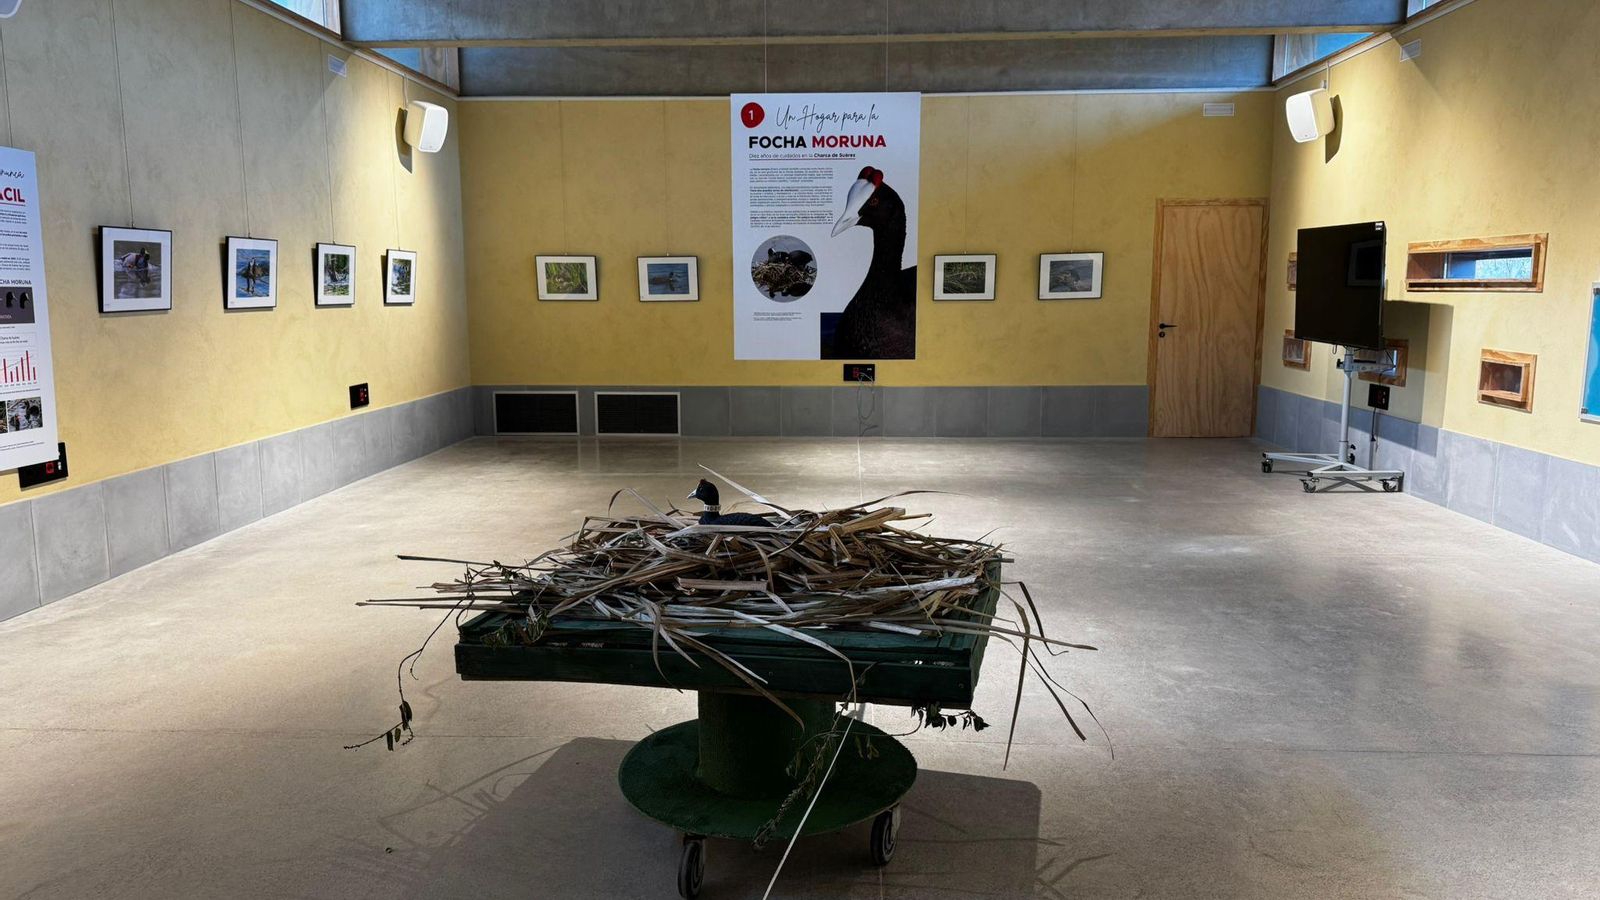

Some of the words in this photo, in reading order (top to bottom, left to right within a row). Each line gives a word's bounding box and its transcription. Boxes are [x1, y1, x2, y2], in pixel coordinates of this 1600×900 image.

[748, 109, 754, 120] 1
[776, 104, 796, 130] Un
[796, 103, 840, 133] Hogar
[840, 111, 867, 131] para
[867, 103, 880, 127] la
[748, 135, 807, 149] FOCHA
[811, 134, 887, 148] MORUNA
